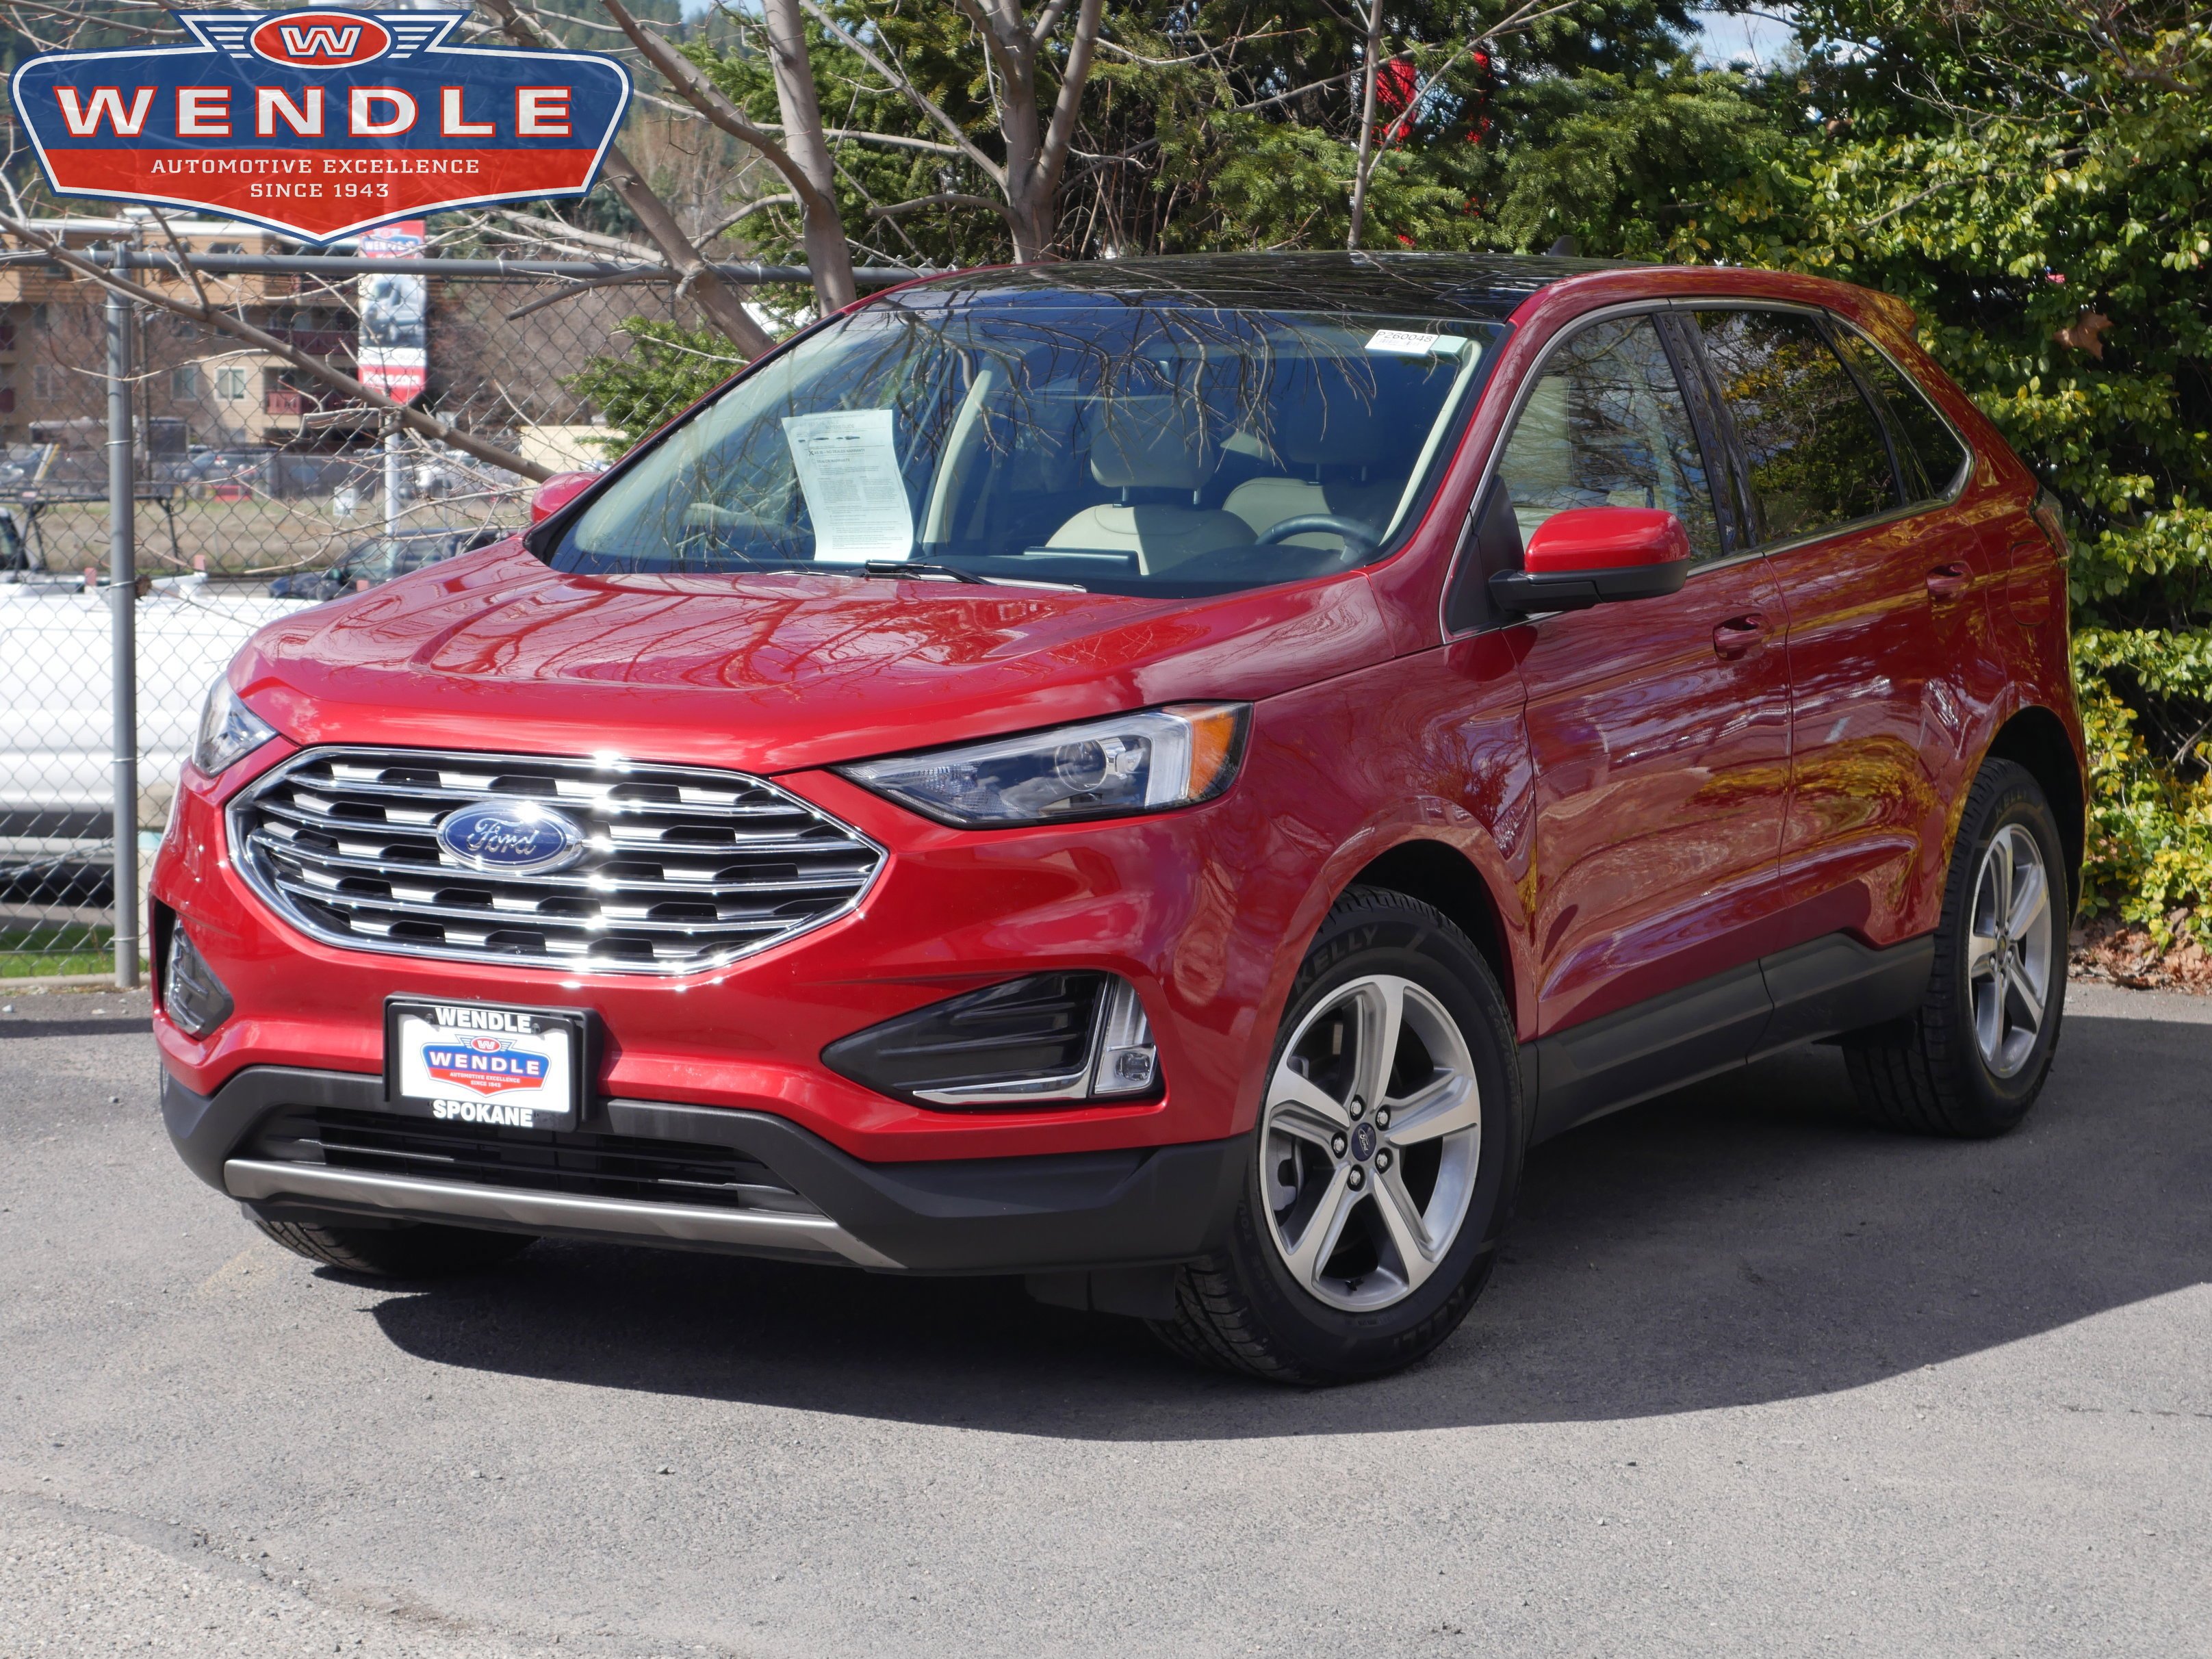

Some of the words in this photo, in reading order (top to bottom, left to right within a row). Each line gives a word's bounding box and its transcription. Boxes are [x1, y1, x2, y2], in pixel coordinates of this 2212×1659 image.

[1376, 331, 1433, 342] P260048
[466, 818, 539, 855] Ford
[1294, 925, 1379, 994] KELLY
[435, 1007, 532, 1034] WENDLE
[429, 1051, 539, 1075] WENDLE
[450, 1072, 485, 1080] AUTOMOTIVE
[486, 1075, 520, 1083] EXCELLENCE
[433, 1099, 533, 1127] SPOKANE
